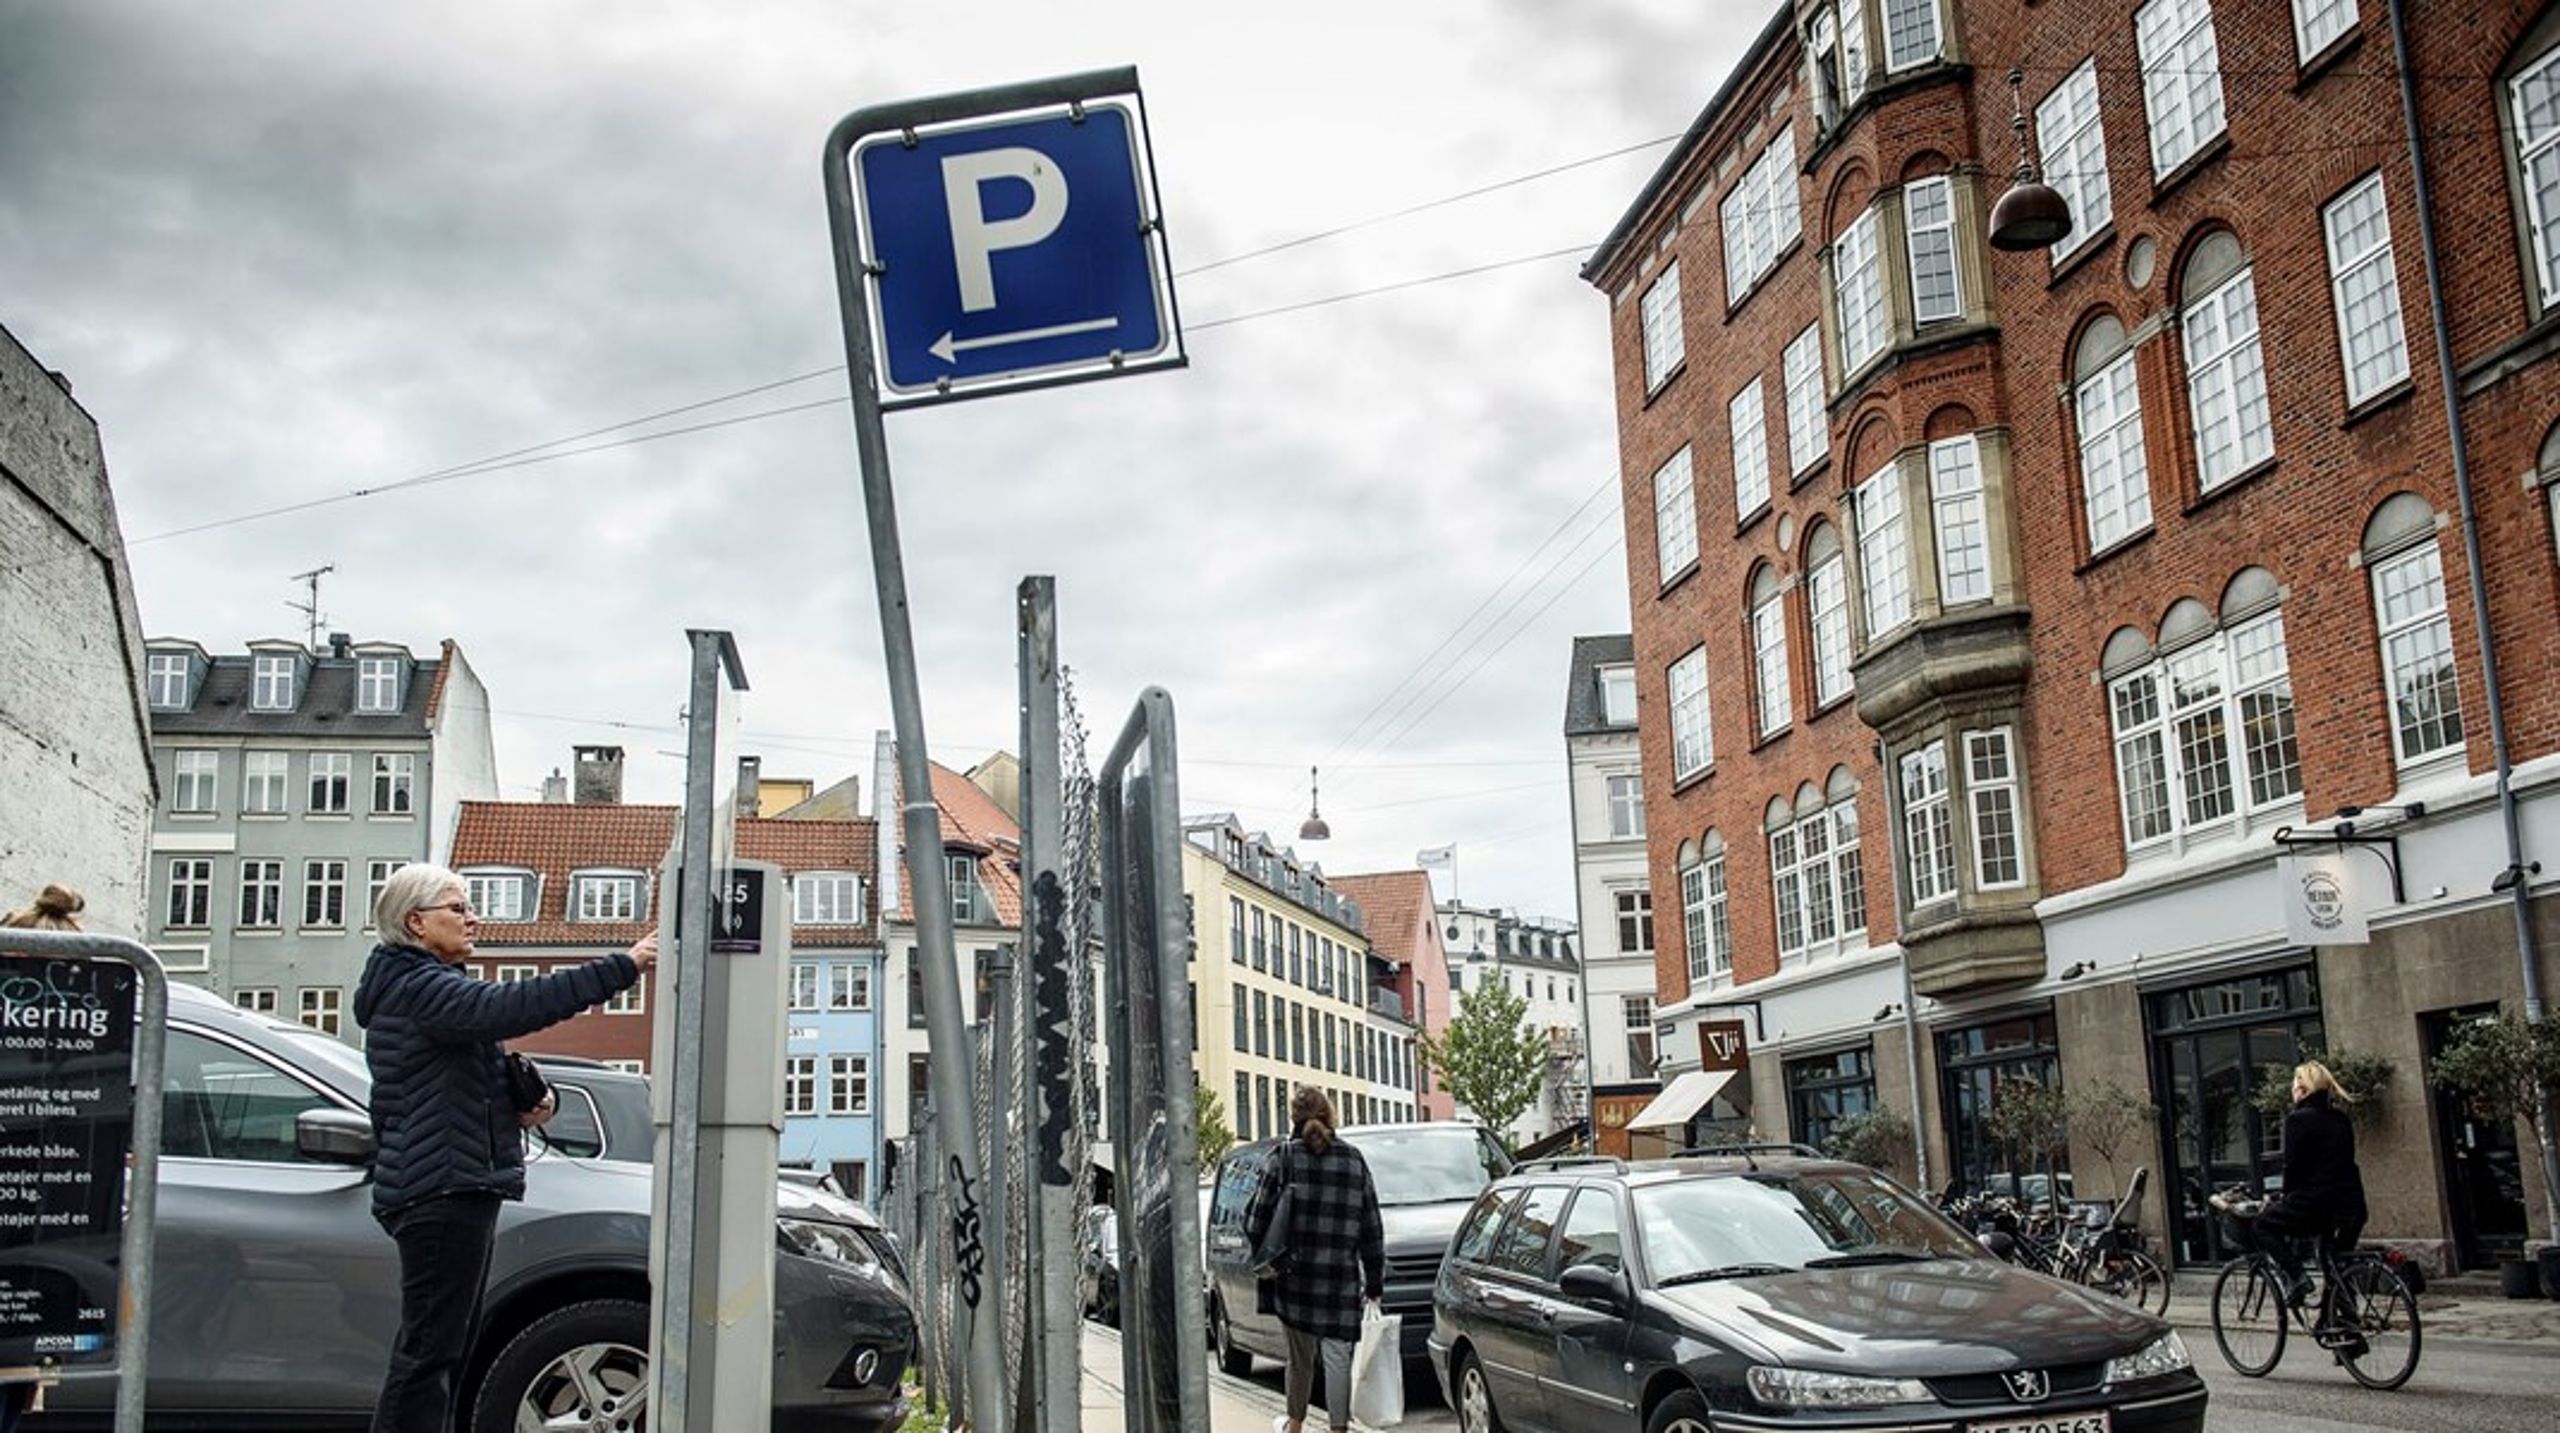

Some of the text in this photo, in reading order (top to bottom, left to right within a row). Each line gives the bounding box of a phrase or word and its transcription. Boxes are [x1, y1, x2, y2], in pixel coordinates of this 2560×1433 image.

[941, 147, 1069, 314] P
[0, 999, 109, 1037] kering
[5, 1036, 46, 1048] 00.00
[56, 1038, 95, 1050] 24.00
[52, 1088, 70, 1103] og
[71, 1088, 101, 1101] med
[36, 1103, 77, 1117] bilens
[42, 1169, 72, 1183] med
[74, 1171, 92, 1183] en
[21, 1186, 42, 1202] kg.
[40, 1211, 70, 1225] med
[72, 1214, 90, 1225] en
